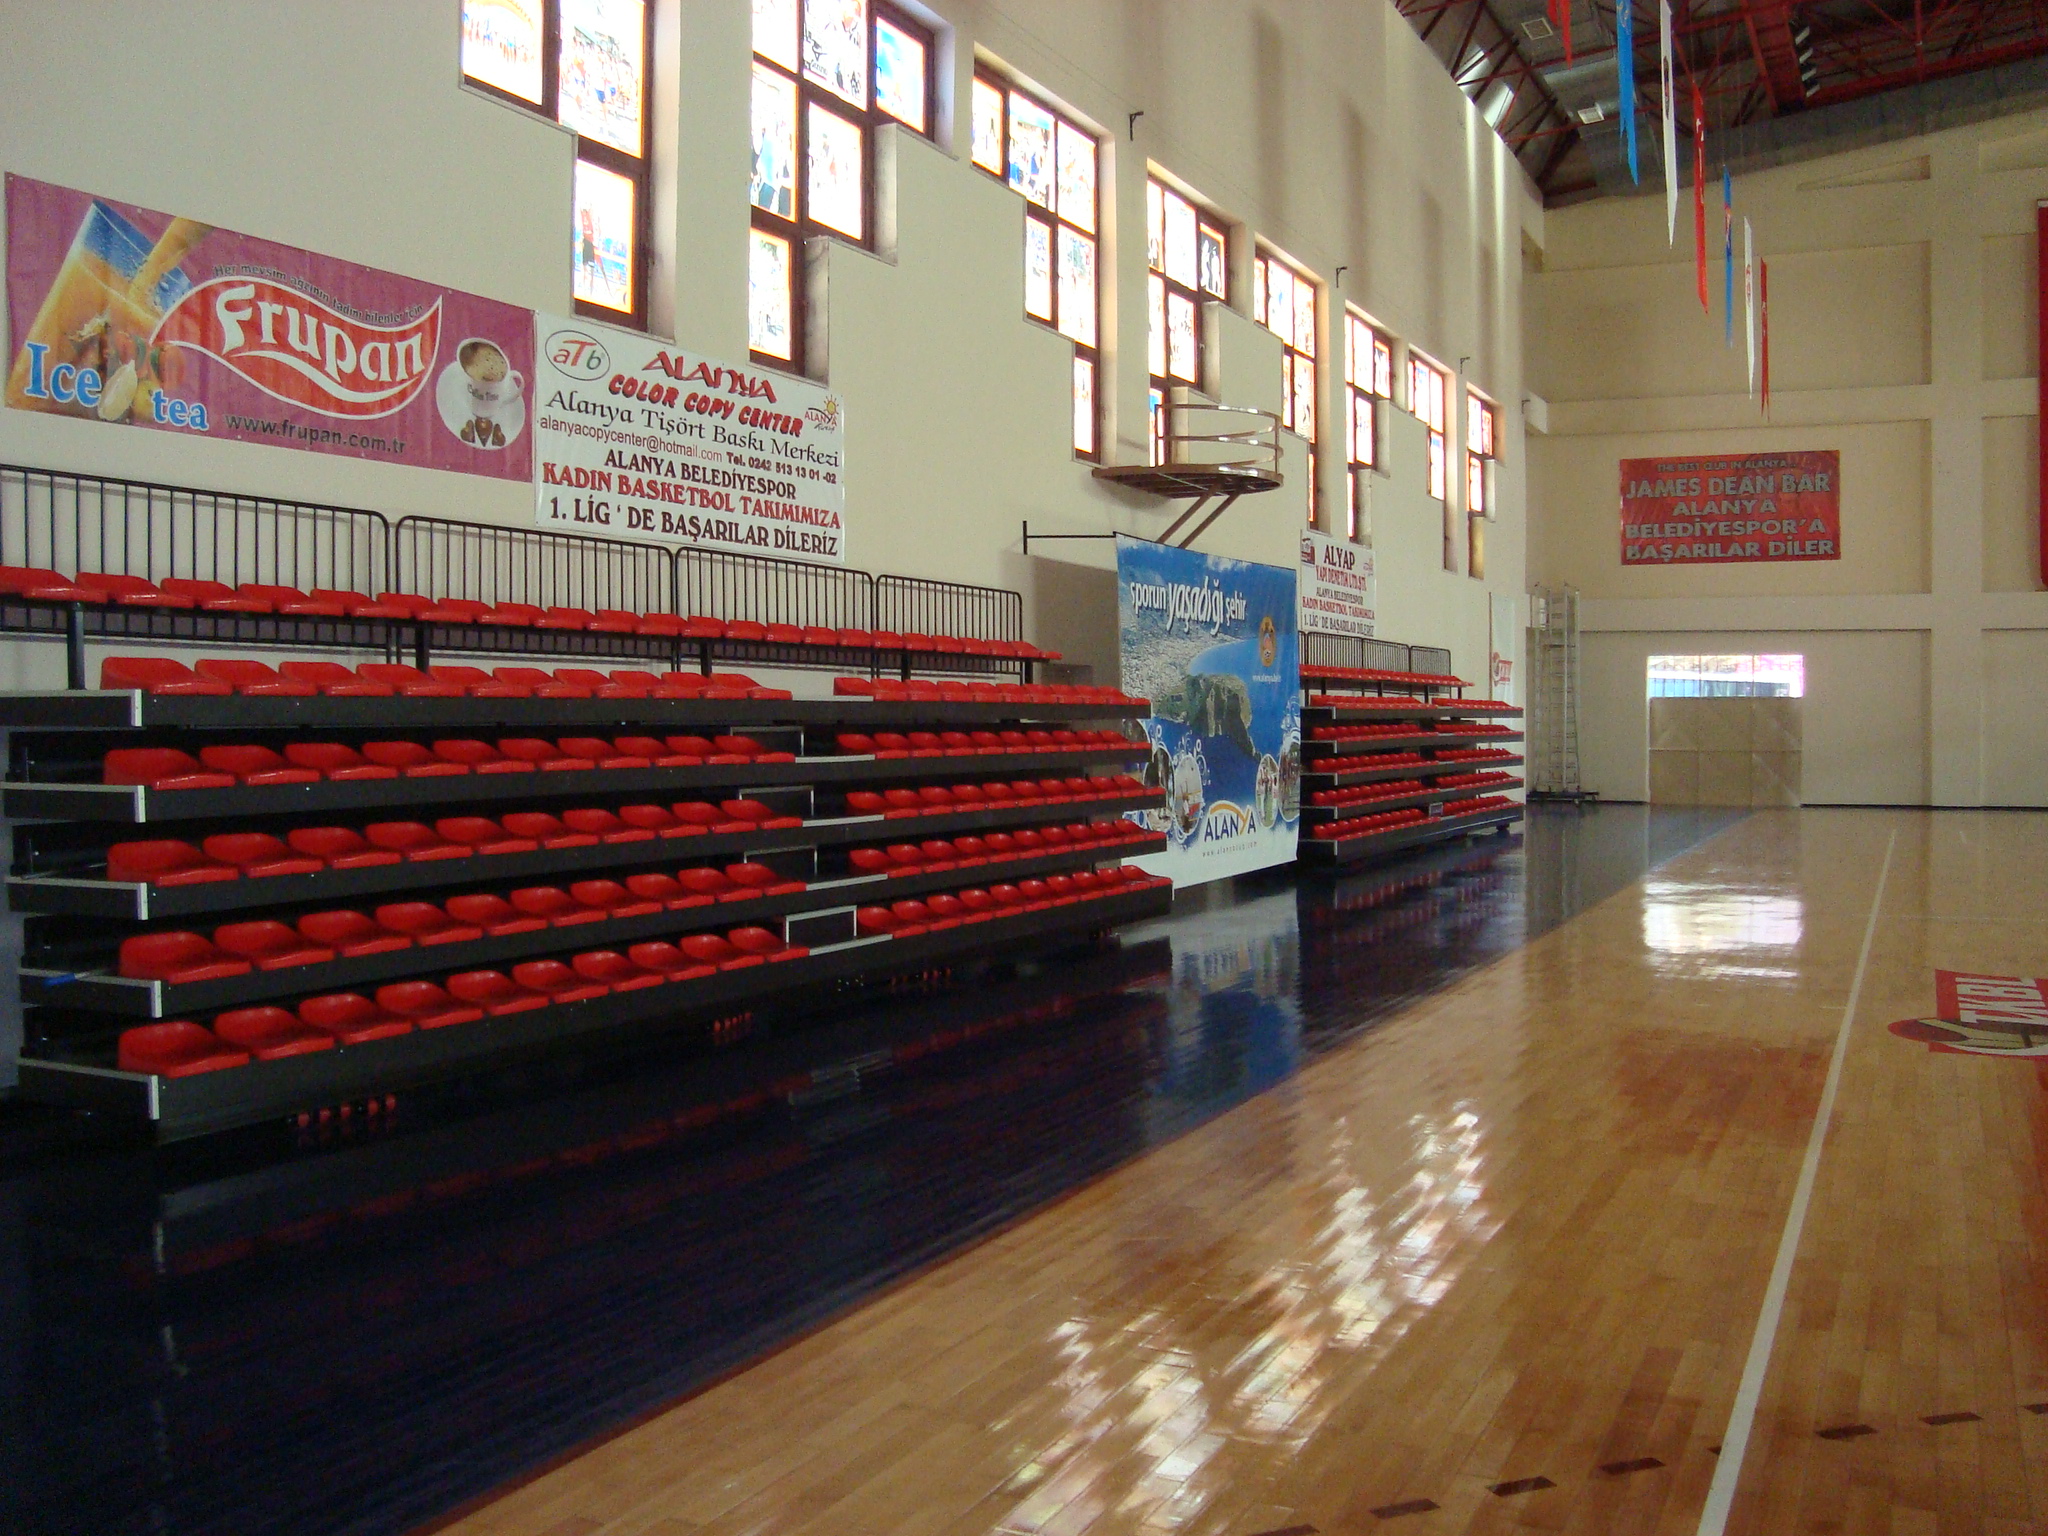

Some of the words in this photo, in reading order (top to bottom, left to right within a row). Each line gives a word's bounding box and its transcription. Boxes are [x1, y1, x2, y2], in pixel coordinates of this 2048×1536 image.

[214, 264, 236, 277] Her
[241, 264, 286, 280] mevsim
[215, 283, 426, 384] Frupan
[24, 341, 103, 407] Ice
[151, 391, 209, 430] tea
[608, 373, 680, 409] COLOR
[683, 391, 735, 421] COPY
[738, 405, 804, 437] CENTER
[224, 413, 407, 454] www.frupan.com.tr
[540, 414, 723, 463] alanyacopycenter@hotmail.com
[546, 390, 634, 427] Alanya
[641, 407, 706, 439] Tişört
[712, 425, 765, 452] Baskı
[770, 437, 840, 468] Merkezi
[604, 448, 676, 478] ALANYA
[680, 461, 797, 501] BELEDİYESPOR
[726, 451, 746, 467] Tel.
[748, 455, 772, 472] 0242
[775, 459, 793, 475] 513
[795, 462, 808, 478] 13
[809, 465, 821, 481] 01
[823, 470, 837, 485] -02
[1626, 477, 1701, 499] JAMES
[1708, 474, 1775, 496] DEAN
[1781, 472, 1831, 493] BAR
[1657, 463, 1675, 473] THE
[1678, 462, 1699, 472] BEST
[1731, 460, 1742, 470] IN
[542, 461, 612, 491] KADIN
[618, 474, 735, 514] BASKETBOL
[739, 494, 842, 530] TAKIMIMIZA
[1672, 498, 1777, 516] ALANYA
[550, 496, 567, 519] 1.
[627, 506, 656, 532] DE
[661, 511, 770, 543] BAŞARILAR
[774, 523, 839, 557] DİLERİZ
[1625, 518, 1826, 539] BELEDİYESPOR'A
[1323, 544, 1355, 571] ALYAP
[1626, 542, 1762, 562] BAŞARILAR
[1769, 535, 1835, 556] DİLER
[1130, 581, 1166, 615] sporun
[1166, 575, 1224, 635] yaşadığı
[1226, 590, 1247, 626] şehir
[1302, 596, 1318, 609] KADIN
[1320, 599, 1348, 616] BASKETBOL
[1204, 805, 1256, 843] ALANYA
